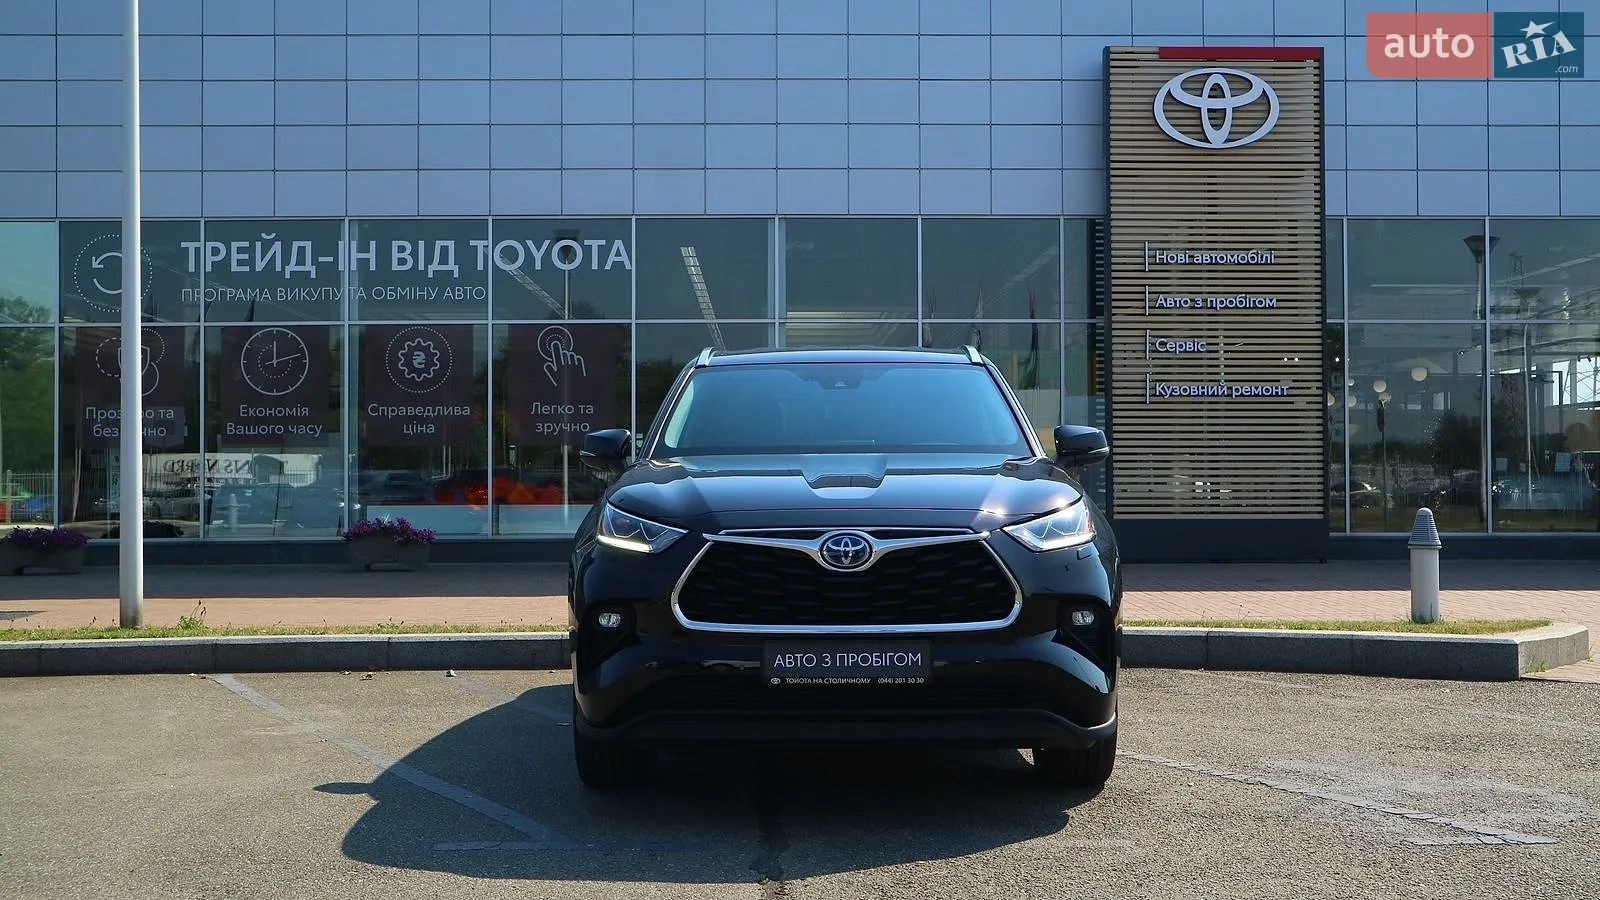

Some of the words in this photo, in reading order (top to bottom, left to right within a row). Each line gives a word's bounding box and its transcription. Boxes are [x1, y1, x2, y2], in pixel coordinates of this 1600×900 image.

[181, 232, 376, 278] ТРЕЙД-ІН
[391, 240, 459, 278] ВІД
[469, 239, 633, 271] TOYOTA
[1156, 250, 1189, 264] Нові
[1193, 250, 1275, 264] автомобілі
[181, 288, 272, 302] ПРОГРАМА
[277, 287, 344, 301] ВИКУПУ
[349, 286, 367, 300] ТА
[372, 286, 439, 300] ОБМІНУ
[443, 286, 486, 300] АВТО
[1156, 294, 1191, 308] Авто
[1194, 297, 1203, 308] з
[1207, 294, 1277, 310] пробігом
[1156, 338, 1207, 354] Сервіс
[1156, 380, 1228, 398] Кузовний
[1232, 384, 1289, 398] ремонт
[160, 409, 174, 419] та
[239, 404, 309, 417] Економія
[368, 403, 471, 418] Справедлива
[531, 402, 574, 414] Легко
[579, 405, 594, 414] та
[226, 423, 285, 435] Вашого
[289, 424, 322, 437] часу
[403, 421, 435, 434] ціна
[535, 421, 590, 434] зручно
[774, 654, 817, 668] АВТО
[836, 652, 922, 667] ПРОБІГОМ
